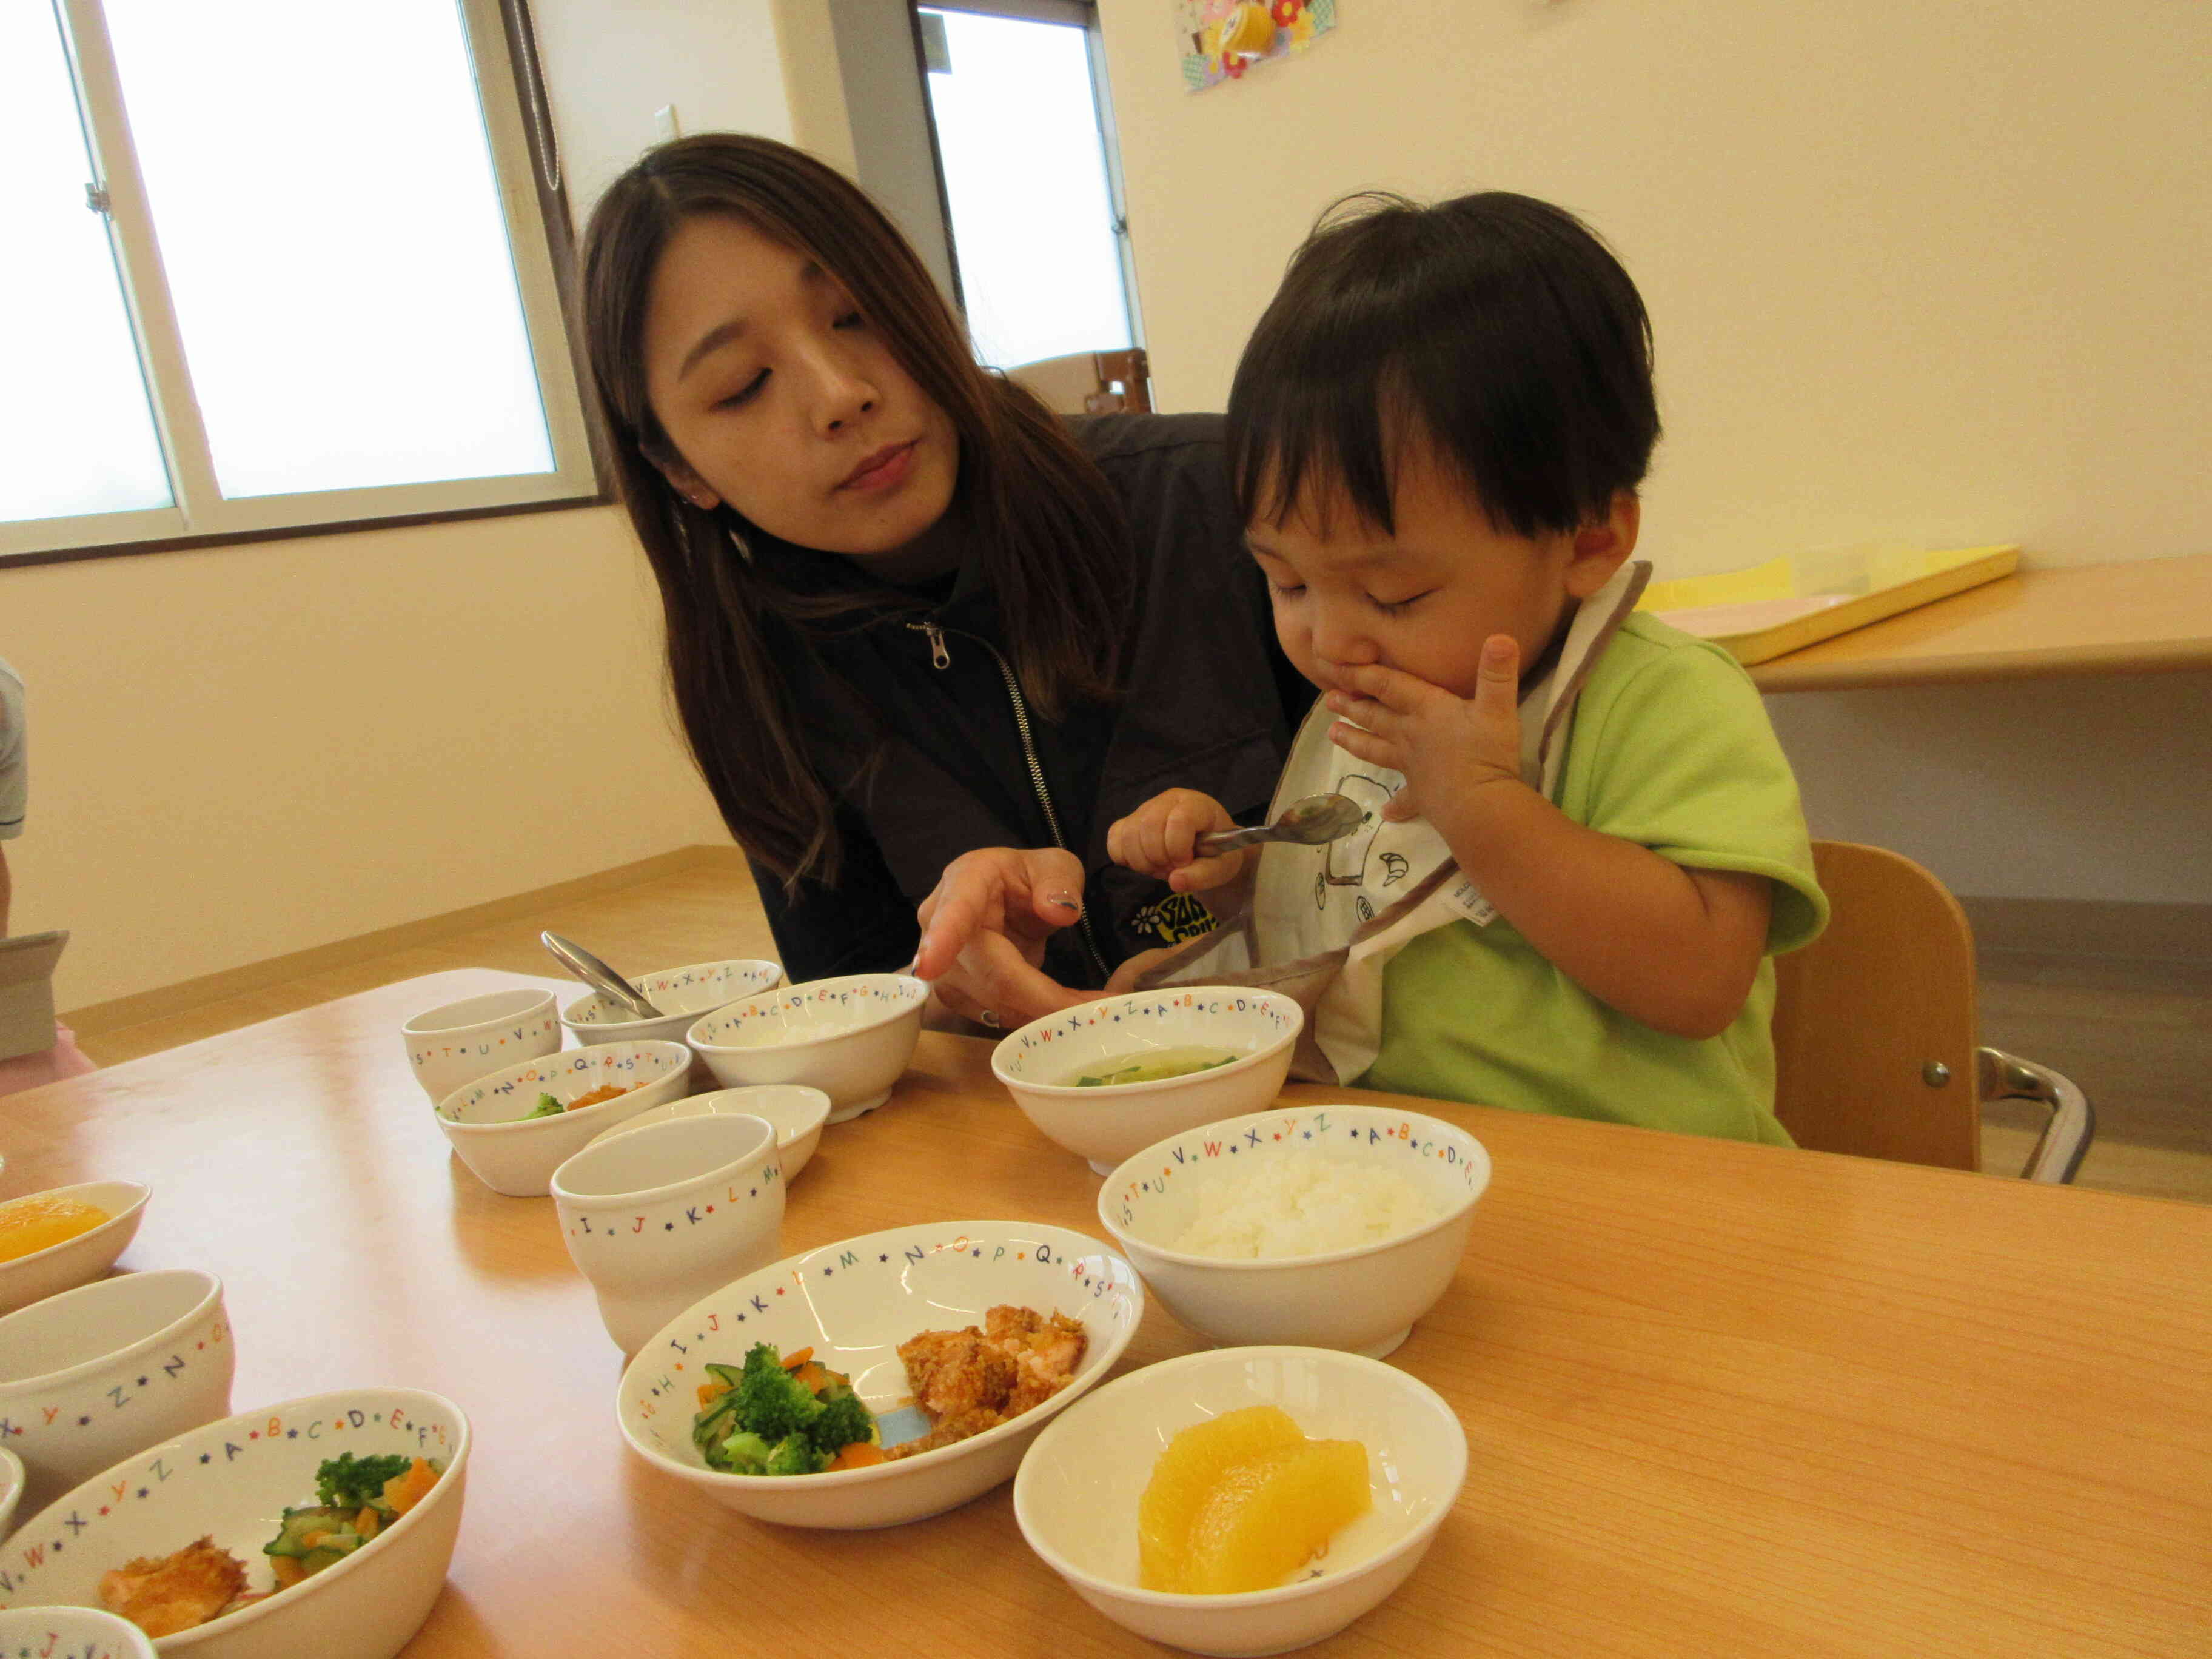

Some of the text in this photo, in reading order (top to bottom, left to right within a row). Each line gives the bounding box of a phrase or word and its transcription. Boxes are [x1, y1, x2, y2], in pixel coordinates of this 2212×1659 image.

[817, 989, 828, 1002] E
[1039, 1029, 1054, 1043] W
[1068, 1016, 1082, 1032] X
[1124, 1000, 1138, 1015] Z
[1156, 1004, 1168, 1017] A
[1183, 993, 1193, 1007] B
[1235, 998, 1247, 1011] D
[574, 1057, 589, 1070] Q
[1153, 1176, 1164, 1194] U
[1171, 1146, 1184, 1164] V
[1203, 1141, 1222, 1158] W
[1244, 1128, 1262, 1148] X
[1284, 1119, 1298, 1136] Y
[1313, 1113, 1332, 1132] Z
[1369, 1127, 1381, 1145] A
[1398, 1122, 1410, 1141] B
[1422, 1142, 1433, 1157] C
[1447, 1145, 1456, 1164] D
[580, 1217, 592, 1234] I
[632, 1217, 646, 1234] J
[686, 1206, 703, 1225] K
[728, 1187, 739, 1204] L
[670, 1339, 688, 1355] I
[708, 1313, 719, 1332] J
[750, 1295, 769, 1313] K
[839, 1250, 859, 1270] M
[905, 1245, 925, 1266] N
[993, 1245, 1005, 1262] P
[1036, 1244, 1051, 1264] Q
[42, 1406, 59, 1426] Y
[107, 1386, 131, 1409] Z
[164, 1355, 186, 1378] N
[23, 1543, 44, 1569] W
[64, 1510, 88, 1536] X
[111, 1480, 127, 1503] Y
[149, 1458, 174, 1482] Z
[224, 1441, 243, 1461] A
[267, 1416, 282, 1438] B
[307, 1420, 323, 1439] C
[347, 1409, 364, 1428] D
[390, 1407, 404, 1430] E
[418, 1427, 427, 1449] F
